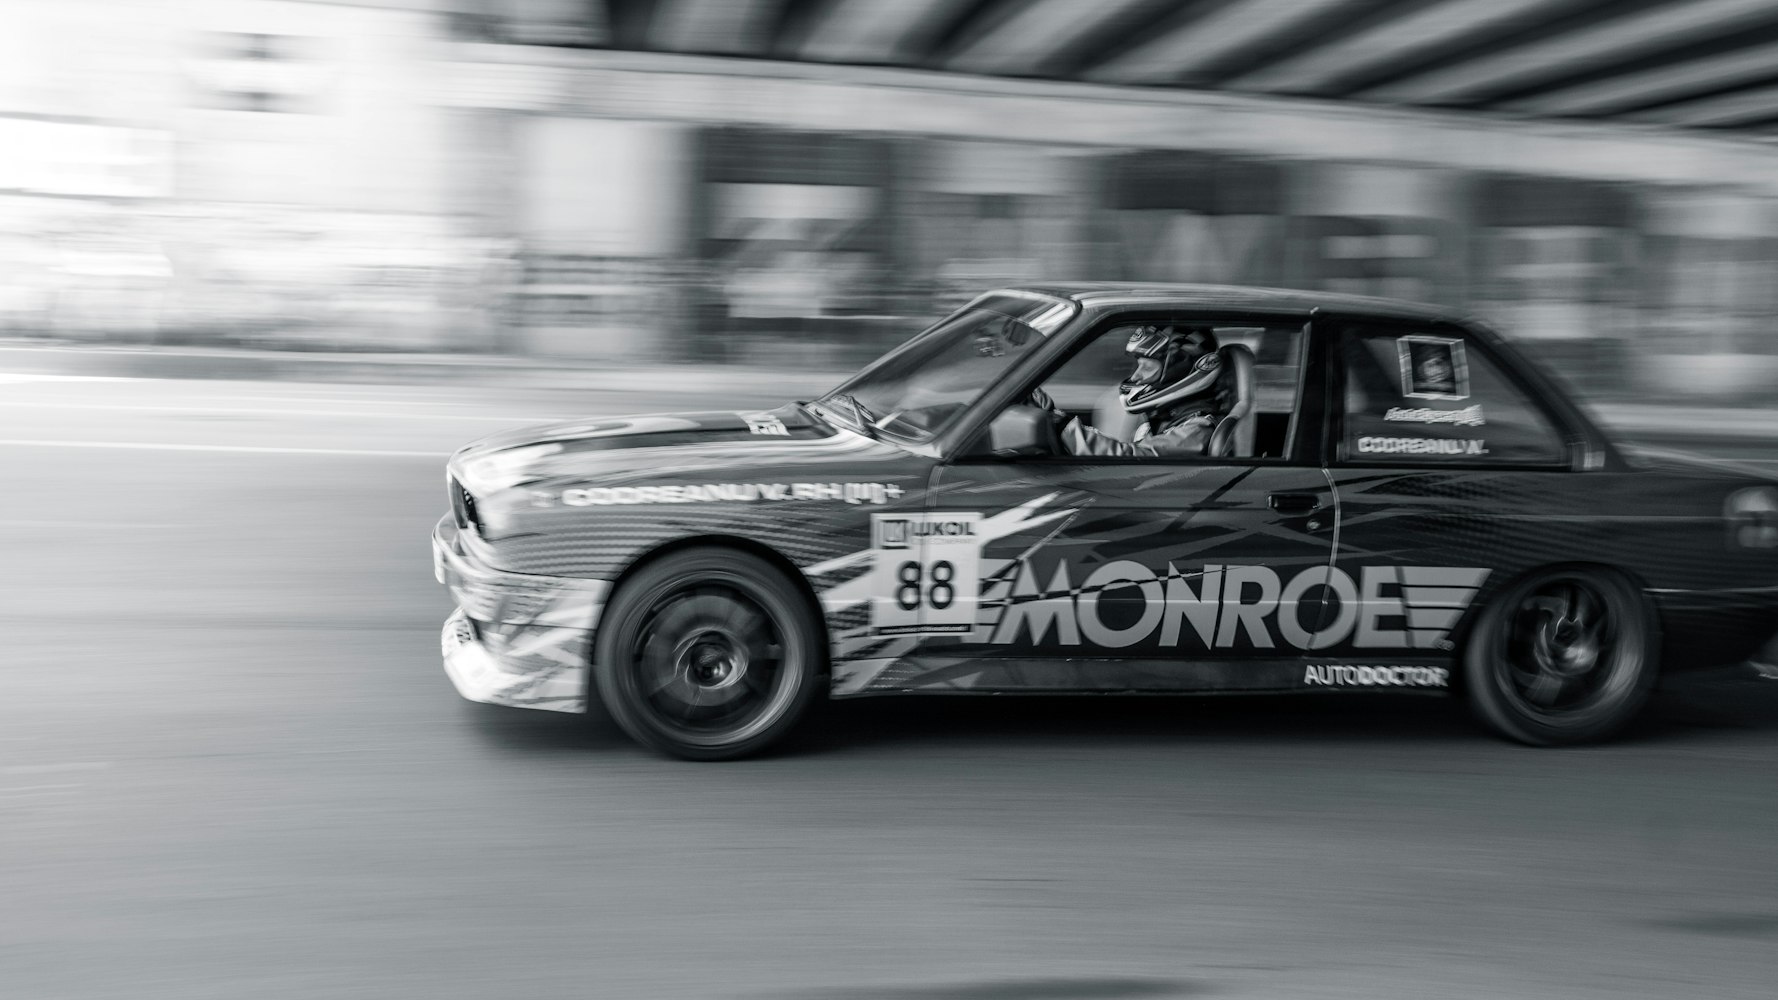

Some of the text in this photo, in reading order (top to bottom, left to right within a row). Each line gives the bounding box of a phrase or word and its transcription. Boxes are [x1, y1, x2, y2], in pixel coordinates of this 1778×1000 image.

[897, 560, 955, 611] 88
[992, 557, 1411, 651] MONROE
[1304, 664, 1449, 687] AUTODOCTOR
